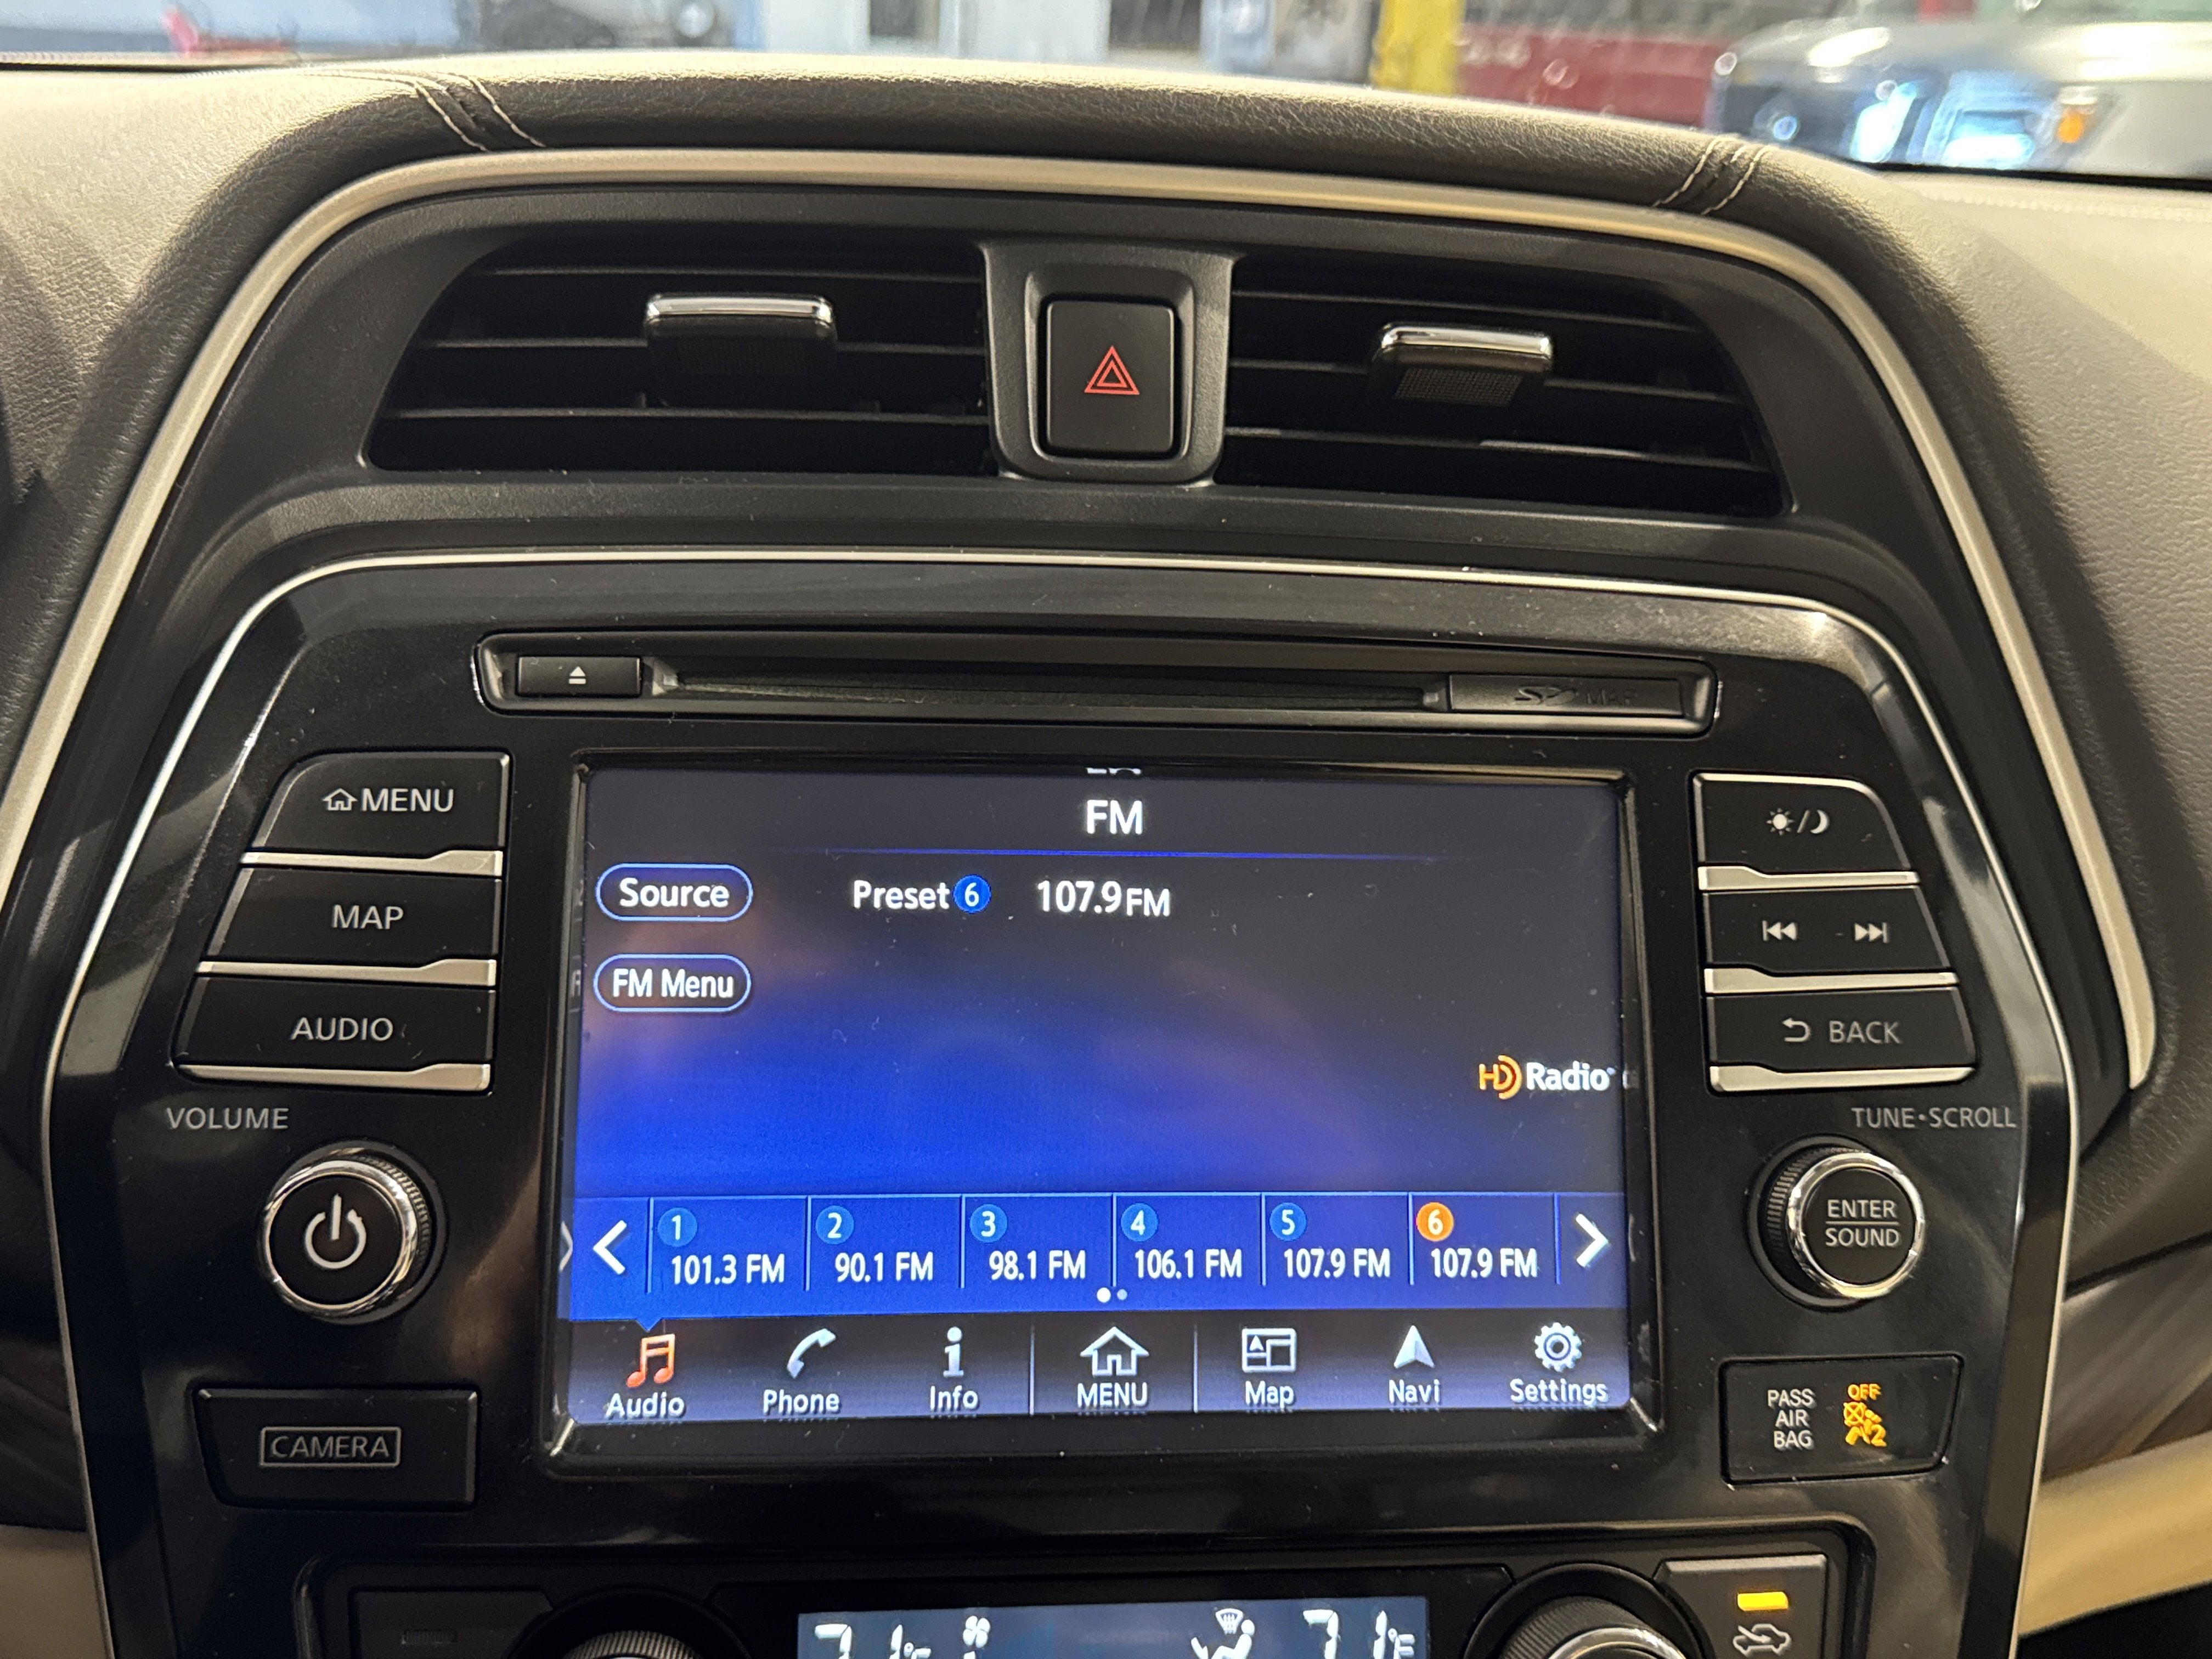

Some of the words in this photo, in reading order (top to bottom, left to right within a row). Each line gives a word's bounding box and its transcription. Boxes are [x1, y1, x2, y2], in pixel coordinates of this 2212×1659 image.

[361, 788, 455, 812] MENU
[1086, 799, 1143, 835] FM
[618, 877, 730, 909] Source
[853, 880, 950, 910] Preset
[963, 882, 980, 908] 6
[332, 905, 404, 929] MAP
[612, 968, 653, 998] FM
[661, 968, 733, 998] Menu
[291, 1017, 394, 1041] AUDIO
[1829, 1021, 1900, 1045] BACK
[1479, 1054, 1522, 1101] HD
[1526, 1060, 1610, 1091] Radio
[166, 1107, 289, 1130] VOLUME
[1827, 1199, 1897, 1220] ENTER
[670, 1216, 683, 1240] 1
[827, 1212, 842, 1239] 2
[981, 1211, 996, 1237] 3
[1131, 1210, 1146, 1235] 4
[1280, 1210, 1295, 1235] 5
[1428, 1210, 1443, 1235] 6
[1825, 1228, 1900, 1248] SOUND
[672, 1254, 737, 1285] 101.3
[746, 1254, 785, 1283] FM
[834, 1252, 884, 1283] 90.1
[895, 1251, 933, 1282] FM
[989, 1250, 1037, 1282] 98.1
[1048, 1249, 1086, 1280] FM
[1134, 1249, 1195, 1279] 106.1
[1206, 1248, 1243, 1278] FM
[1284, 1249, 1346, 1279] 107.9
[1354, 1248, 1391, 1278] FM
[1431, 1249, 1493, 1278] 107.9
[1500, 1248, 1537, 1277] FM
[763, 1389, 840, 1414] Phone
[929, 1386, 979, 1412] Info
[1076, 1383, 1148, 1407] MENU
[1245, 1381, 1294, 1408] Map
[1389, 1379, 1440, 1404] Navi
[1510, 1378, 1608, 1406] Settings
[1767, 1389, 1815, 1409] PASS
[1847, 1384, 1882, 1401] OFF
[606, 1392, 685, 1418] Audio
[1775, 1409, 1809, 1428] AIR
[271, 1436, 390, 1458] CAMERA
[1773, 1430, 1813, 1451] BAG
